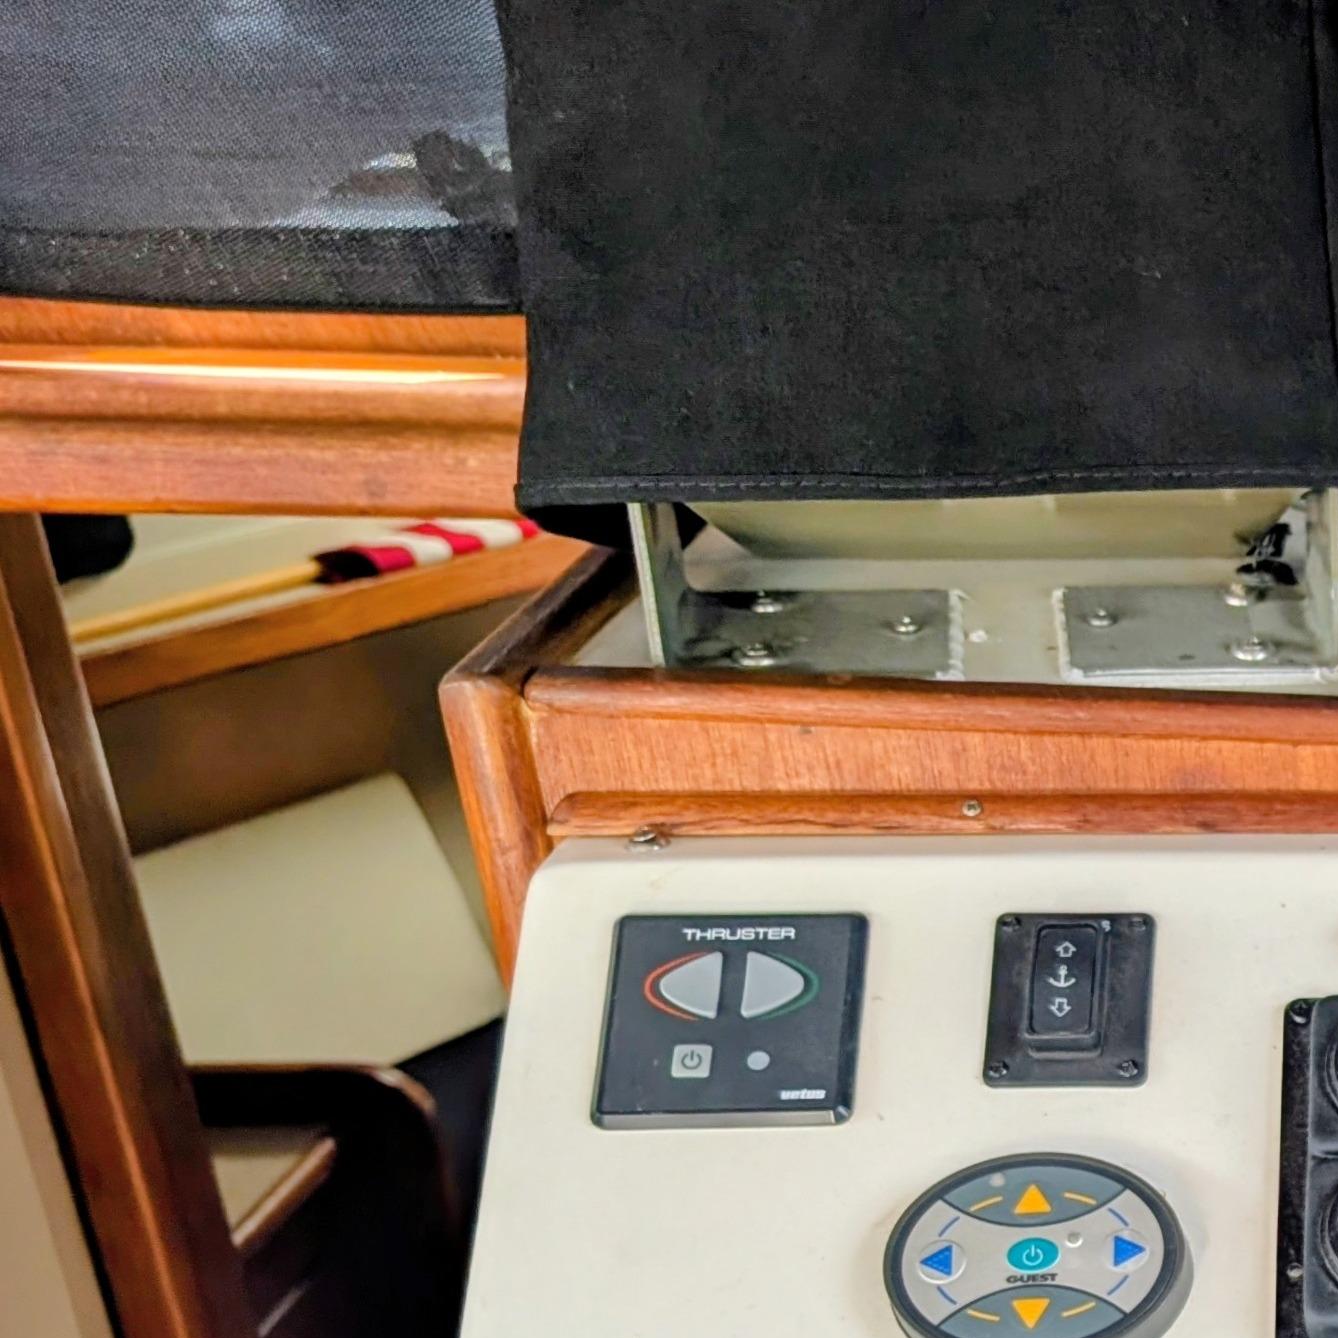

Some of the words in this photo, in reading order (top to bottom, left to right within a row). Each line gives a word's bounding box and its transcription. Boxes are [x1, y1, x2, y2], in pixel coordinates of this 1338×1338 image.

[682, 927, 796, 941] THRUSTER
[779, 1087, 827, 1101] vetus
[1006, 1272, 1058, 1284] GUEST
